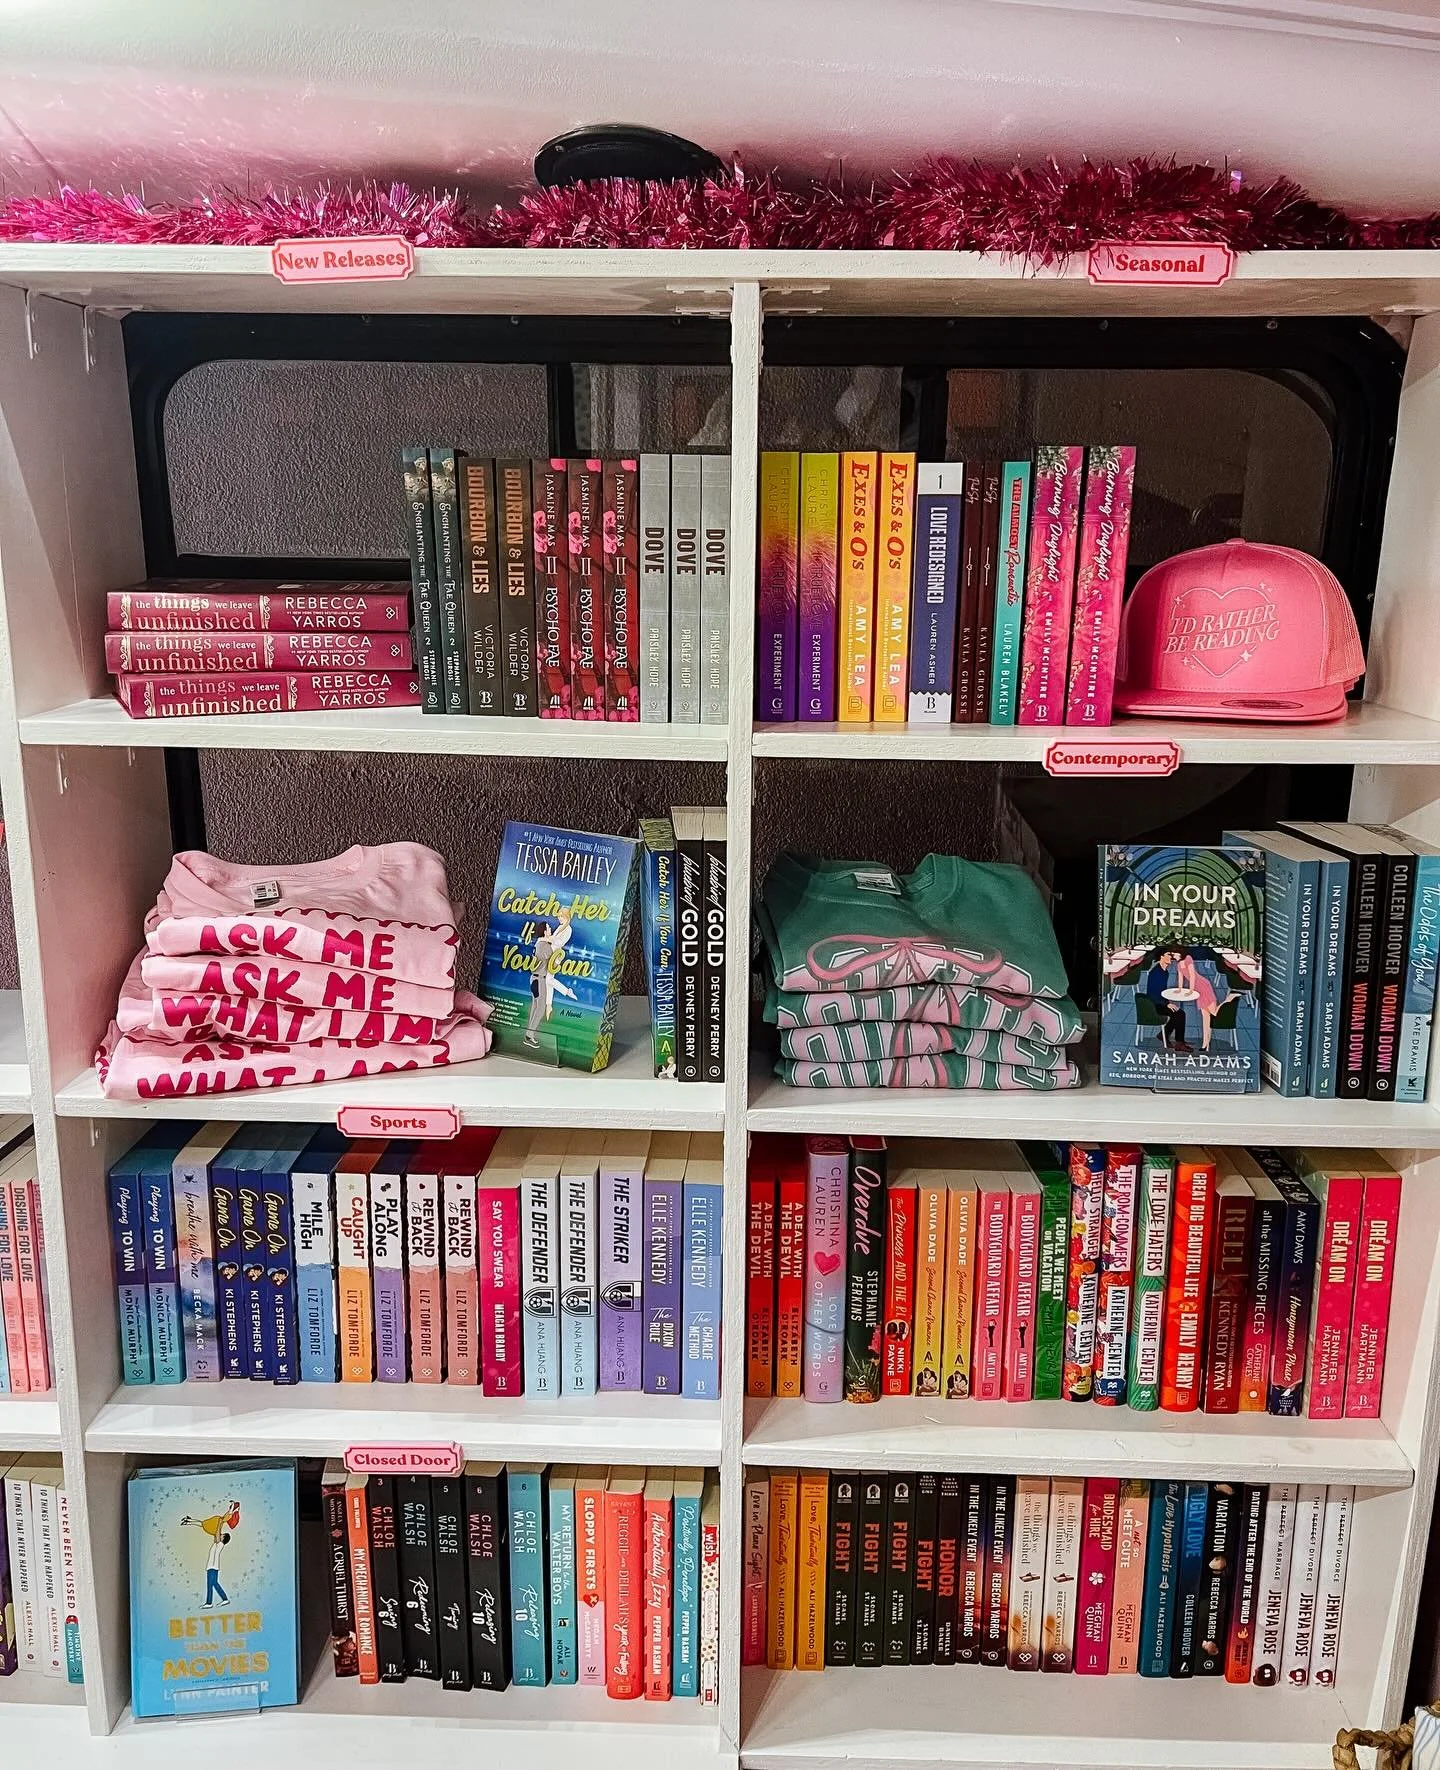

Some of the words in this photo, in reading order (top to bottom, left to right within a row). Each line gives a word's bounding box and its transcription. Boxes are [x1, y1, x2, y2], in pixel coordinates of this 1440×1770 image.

[279, 252, 318, 270] New
[323, 250, 405, 269] Releases
[1116, 254, 1205, 273] Seasonal
[467, 466, 487, 542] BOURBON
[580, 475, 589, 521] JASMINE
[1100, 459, 1119, 515] Burning
[473, 546, 485, 556] &
[582, 526, 590, 547] MAS
[645, 528, 664, 573] DOVE
[677, 529, 696, 575] DOVE
[706, 529, 725, 575] DOVE
[1095, 519, 1113, 580] Daylight
[472, 560, 489, 594] LIES
[927, 535, 946, 604] REDESIGNED
[135, 612, 255, 630] unfinished
[136, 600, 150, 608] the
[154, 596, 209, 610] things
[232, 600, 252, 609] leave
[285, 597, 367, 609] REBECCA
[1169, 618, 1196, 636] I'D
[1199, 605, 1277, 632] RATHER
[292, 616, 361, 628] YARROS
[855, 605, 867, 644] AMY
[1092, 611, 1101, 642] EMILY
[1164, 636, 1191, 654] BE
[1192, 620, 1280, 651] READING
[474, 630, 483, 674] WILDER
[485, 624, 495, 679] VICTORIA
[1000, 624, 1012, 664] LAUREN
[681, 668, 690, 688] HOPE
[812, 634, 820, 691] EXPERIMENT
[854, 655, 865, 686] LEA
[312, 674, 392, 688] REBECCA
[999, 670, 1009, 716] BLAKELY
[161, 697, 282, 717] unfinished
[318, 693, 386, 706] YARROS
[1051, 751, 1176, 767] Contemporary
[515, 843, 558, 876] TESSA
[562, 851, 617, 886] BAILEY
[498, 888, 560, 918] Catch
[568, 894, 610, 921] Her
[1134, 883, 1159, 902] IN
[1168, 884, 1236, 904] YOUR
[1360, 864, 1376, 918] COLLEEN
[521, 921, 535, 945] If
[1134, 908, 1236, 929] DREAMS
[200, 924, 302, 960] ASK
[321, 928, 395, 970] ME
[682, 910, 698, 966] GOLD
[1355, 923, 1371, 974] HOOVER
[502, 945, 541, 973] You
[548, 949, 593, 977] Can
[200, 962, 303, 1005] ASK
[322, 972, 395, 1011] ME
[686, 976, 694, 1020] DEVNEY
[162, 995, 314, 1042] WHAT
[1351, 982, 1368, 1030] WOMAN
[686, 1024, 694, 1058] PERRY
[1348, 1034, 1364, 1071] DOWN
[1113, 1051, 1177, 1066] SARAH
[1185, 1055, 1251, 1069] ADAMS
[370, 1115, 427, 1130] Sports
[531, 1183, 547, 1209] THE
[614, 1178, 629, 1203] THE
[1120, 1170, 1132, 1191] THE
[214, 1188, 233, 1225] Game
[311, 1202, 323, 1236] MILE
[386, 1199, 398, 1237] PLAY
[492, 1201, 503, 1221] SAY
[652, 1194, 667, 1223] ELLE
[781, 1202, 792, 1230] THE
[814, 1176, 826, 1237] LAUREN
[830, 1167, 841, 1247] CHRISTINA
[854, 1166, 881, 1255] Overdue
[929, 1194, 938, 1230] OLIVIA
[153, 1229, 164, 1243] TO
[218, 1229, 236, 1249] On
[300, 1213, 312, 1249] HIGH
[341, 1217, 351, 1237] UP
[351, 1197, 364, 1259] CAUGHT
[374, 1202, 387, 1257] ALONG
[448, 1216, 459, 1256] BACK
[458, 1199, 471, 1258] REWIND
[492, 1225, 503, 1247] YOU
[614, 1206, 628, 1263] STRIKER
[794, 1214, 802, 1245] DEAL
[1055, 1218, 1066, 1248] PEOPLE
[1367, 1220, 1387, 1261] DREAM
[155, 1245, 165, 1270] WIN
[532, 1213, 548, 1283] DEFENDER
[651, 1227, 666, 1285] KENNEDY
[780, 1234, 792, 1279] DEVIL
[793, 1248, 801, 1278] WITH
[928, 1233, 937, 1262] DADE
[986, 1214, 1003, 1277] BODYGUARD
[1054, 1251, 1064, 1262] WE
[494, 1250, 503, 1288] SWEAR
[1042, 1243, 1052, 1291] VACATION
[1052, 1265, 1064, 1301] MEET
[1365, 1265, 1382, 1281] ON
[308, 1288, 318, 1303] LIZ
[850, 1275, 863, 1321] PERKINS
[866, 1271, 878, 1328] STEPHANIE
[1110, 1289, 1126, 1335] KATHERINE
[226, 1301, 236, 1351] STEPHENS
[308, 1306, 320, 1355] TOMFORDE
[1179, 1312, 1198, 1348] EMILY
[1107, 1338, 1123, 1379] CENTER
[1176, 1352, 1194, 1389] HENRY
[353, 1454, 406, 1466] Closed
[410, 1454, 450, 1466] Door
[61, 1497, 69, 1533] NEVER
[584, 1497, 595, 1544] SLOPPY
[994, 1512, 1005, 1537] LIKELY
[1089, 1518, 1101, 1538] HIRE
[1101, 1494, 1115, 1550] BRIDESMAID
[1213, 1499, 1229, 1552] VARIATION
[64, 1538, 72, 1565] BEEN
[470, 1515, 481, 1557] WALSH
[481, 1516, 493, 1557] CHLOE
[552, 1532, 561, 1575] WALTER
[835, 1522, 850, 1572] FIGHT
[892, 1522, 908, 1571] FIGHT
[992, 1539, 1004, 1564] EVENT
[585, 1549, 596, 1590] FIRSTS
[939, 1539, 955, 1597] HONOR
[66, 1571, 75, 1609] KISSED
[553, 1577, 562, 1605] BOYS
[991, 1573, 1002, 1608] REBECCA
[169, 1612, 262, 1639] BETTER
[990, 1608, 999, 1639] YARROS
[1297, 1593, 1313, 1629] JENEVA
[1295, 1632, 1309, 1657] ROSE
[163, 1652, 269, 1680] MOVIES
